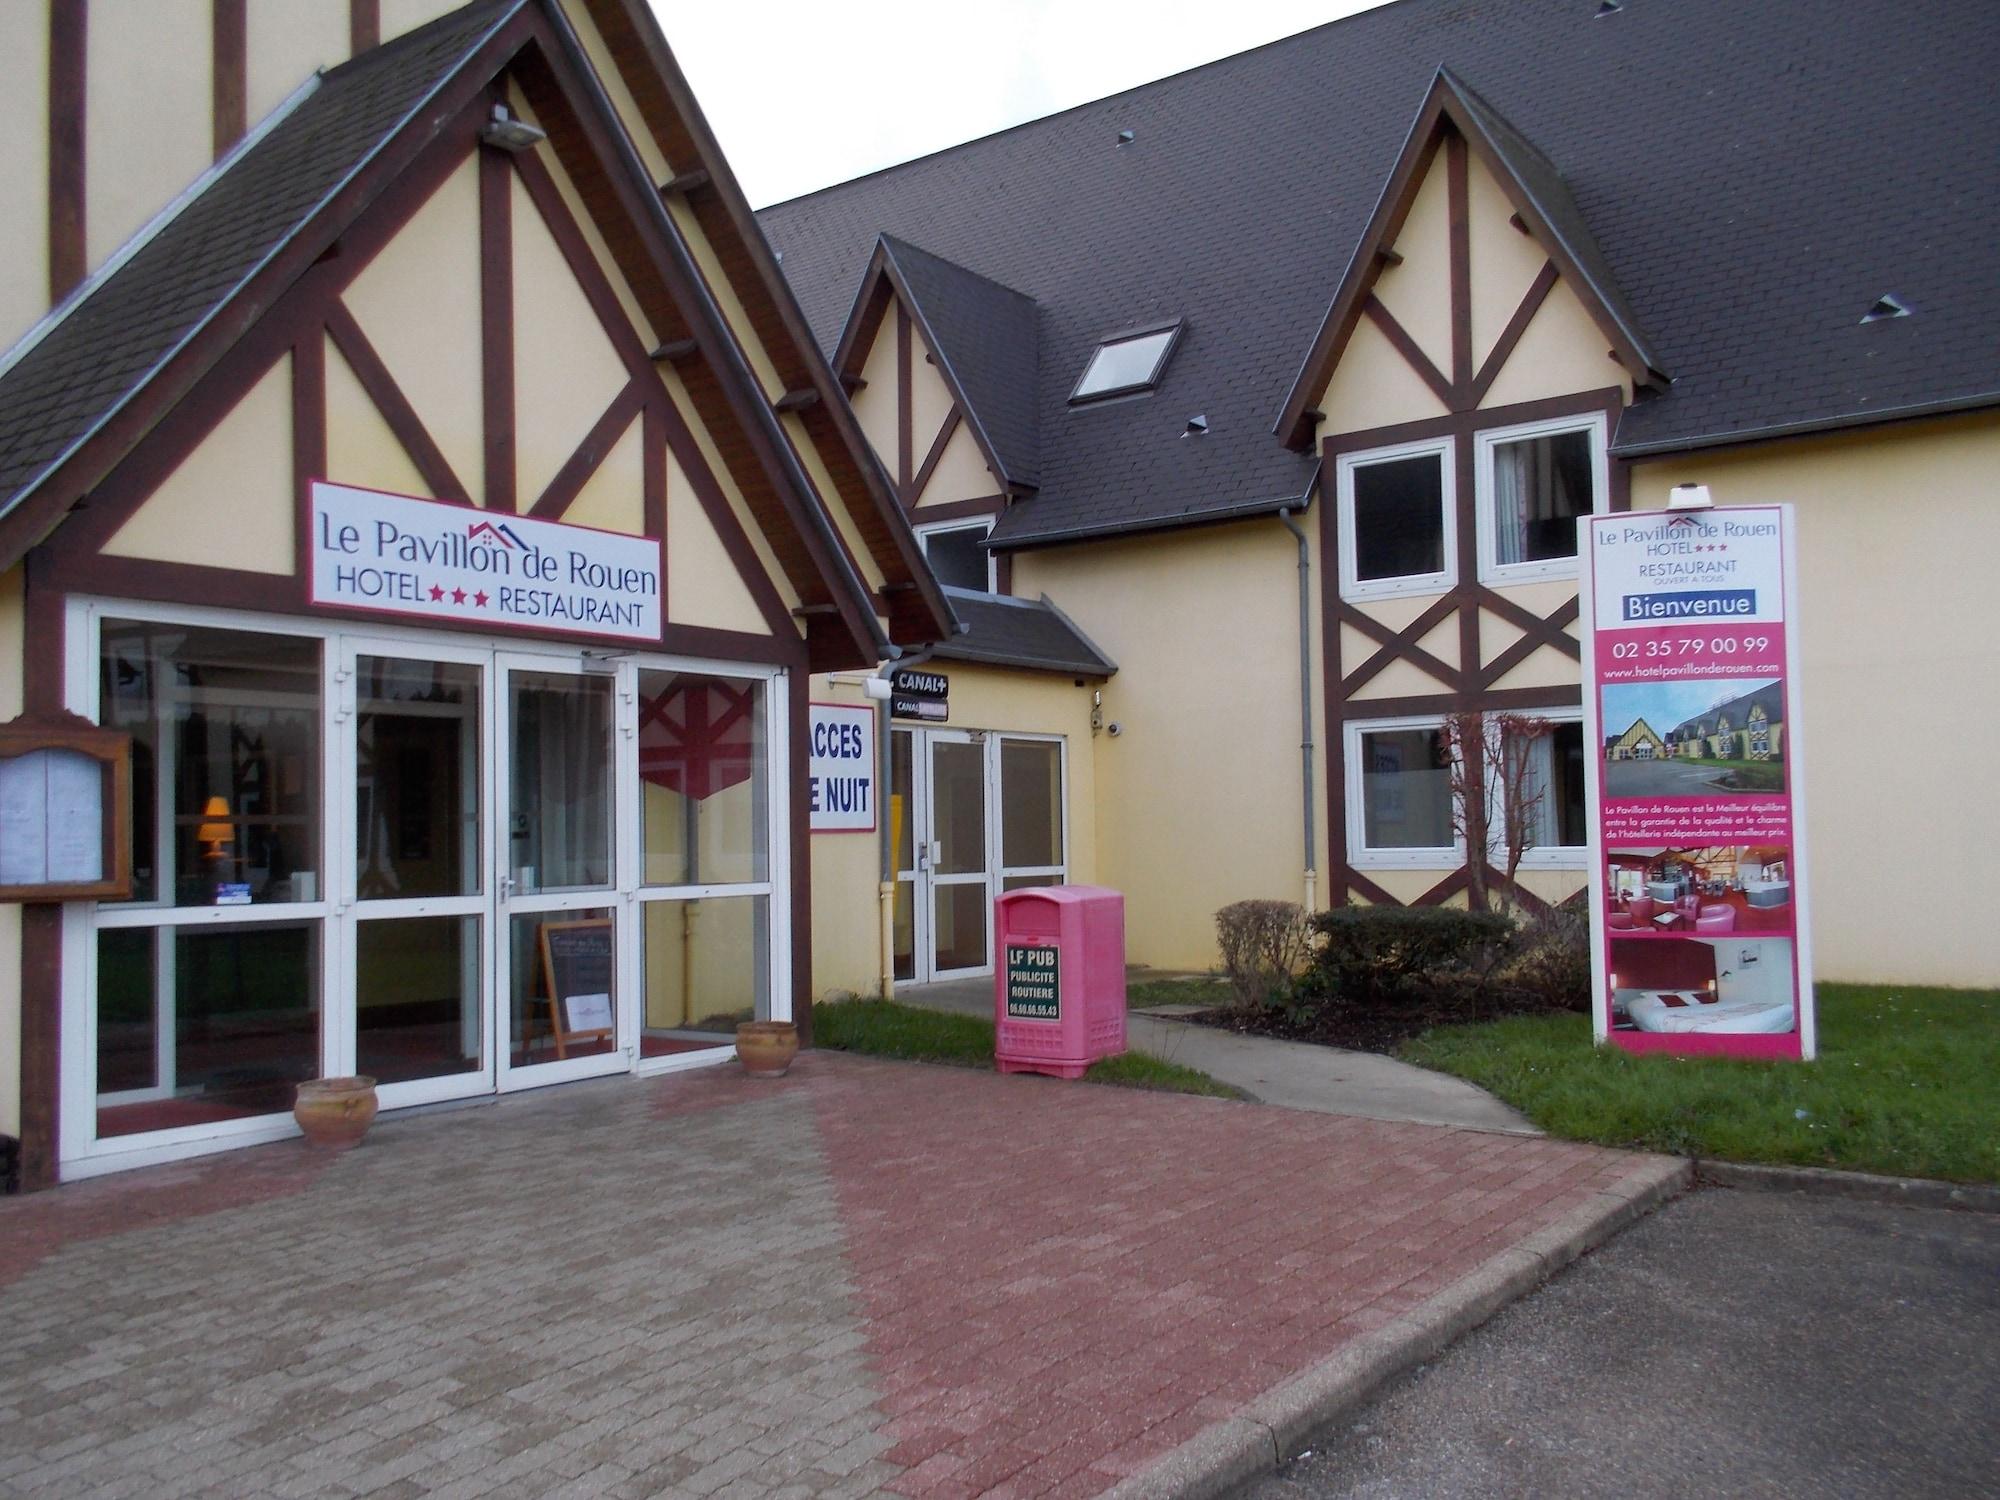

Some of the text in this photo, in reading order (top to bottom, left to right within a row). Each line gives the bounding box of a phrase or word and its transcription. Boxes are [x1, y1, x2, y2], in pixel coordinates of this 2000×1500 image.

[1599, 521, 1776, 545] Le Pavillon de Rouen
[320, 512, 656, 595] Le Pavillon de Rouen
[1647, 542, 1693, 557] HOTEL
[1639, 560, 1737, 577] RESTAURANT
[1654, 577, 1689, 586] OUVERT
[1701, 575, 1724, 584] TOUS
[336, 565, 644, 627] HOTEL RESTAURANT
[1629, 596, 1750, 618] Bienvenue
[1612, 637, 1769, 659] 02 35 79 00 99
[1604, 663, 1779, 678] www.hotelpavillonderouen.com
[899, 673, 947, 693] CANAL+
[827, 777, 870, 812] NUIT
[1605, 806, 1614, 814] Le
[1616, 805, 1648, 814] Pavillon
[1650, 805, 1662, 814] de
[1664, 805, 1690, 814] Rouen
[1692, 805, 1704, 813] est
[1716, 804, 1749, 813] Meilleur
[1605, 818, 1626, 827] entre
[1629, 818, 1638, 826] la
[1640, 817, 1676, 828] garantie
[1679, 817, 1690, 825] de
[1693, 816, 1702, 825] la
[1704, 816, 1733, 827] qualité
[1735, 816, 1743, 825] et
[1756, 816, 1787, 824] charme
[1606, 831, 1617, 839] de
[1663, 829, 1720, 840] indépendante
[1722, 830, 1733, 838] au
[1735, 828, 1766, 837] meilleur
[1010, 949, 1055, 966] LF PUB
[1010, 970, 1055, 984] PUBLICITE
[1011, 986, 1054, 999] ROUTIERE
